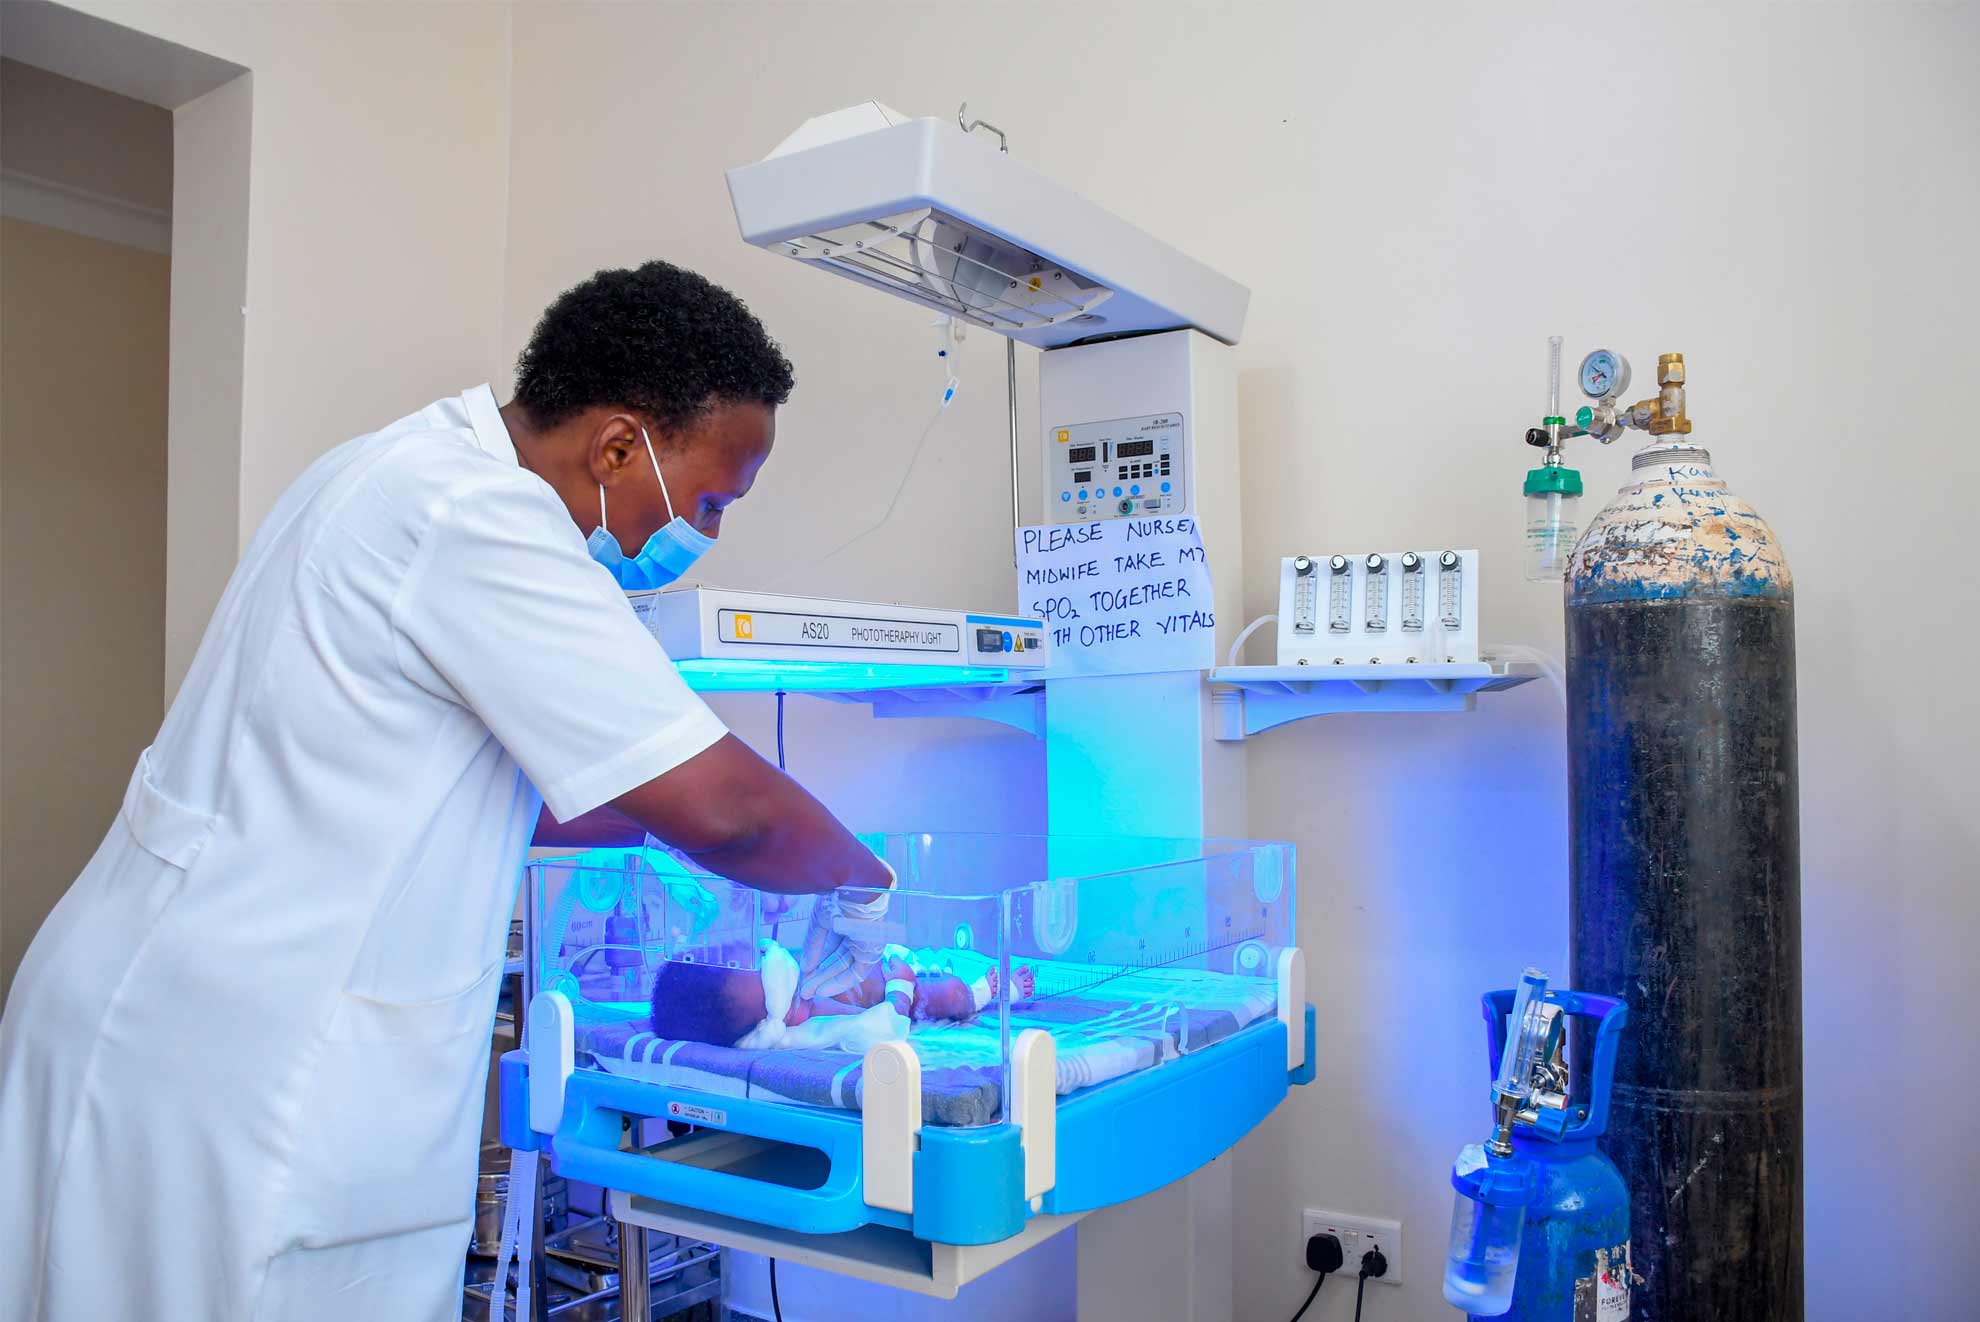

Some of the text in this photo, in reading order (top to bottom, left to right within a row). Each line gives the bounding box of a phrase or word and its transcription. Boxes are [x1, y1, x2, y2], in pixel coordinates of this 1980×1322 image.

[1024, 522, 1103, 554] PLEASE
[1027, 560, 1101, 585] MIDWIFE
[1114, 552, 1165, 574] TAKE
[1090, 578, 1191, 613] TOGETHER
[801, 621, 942, 645] AS20 PHOTOTHERAPHY LIGHT
[1080, 620, 1141, 647] OTHER
[1156, 609, 1215, 635] VITALS
